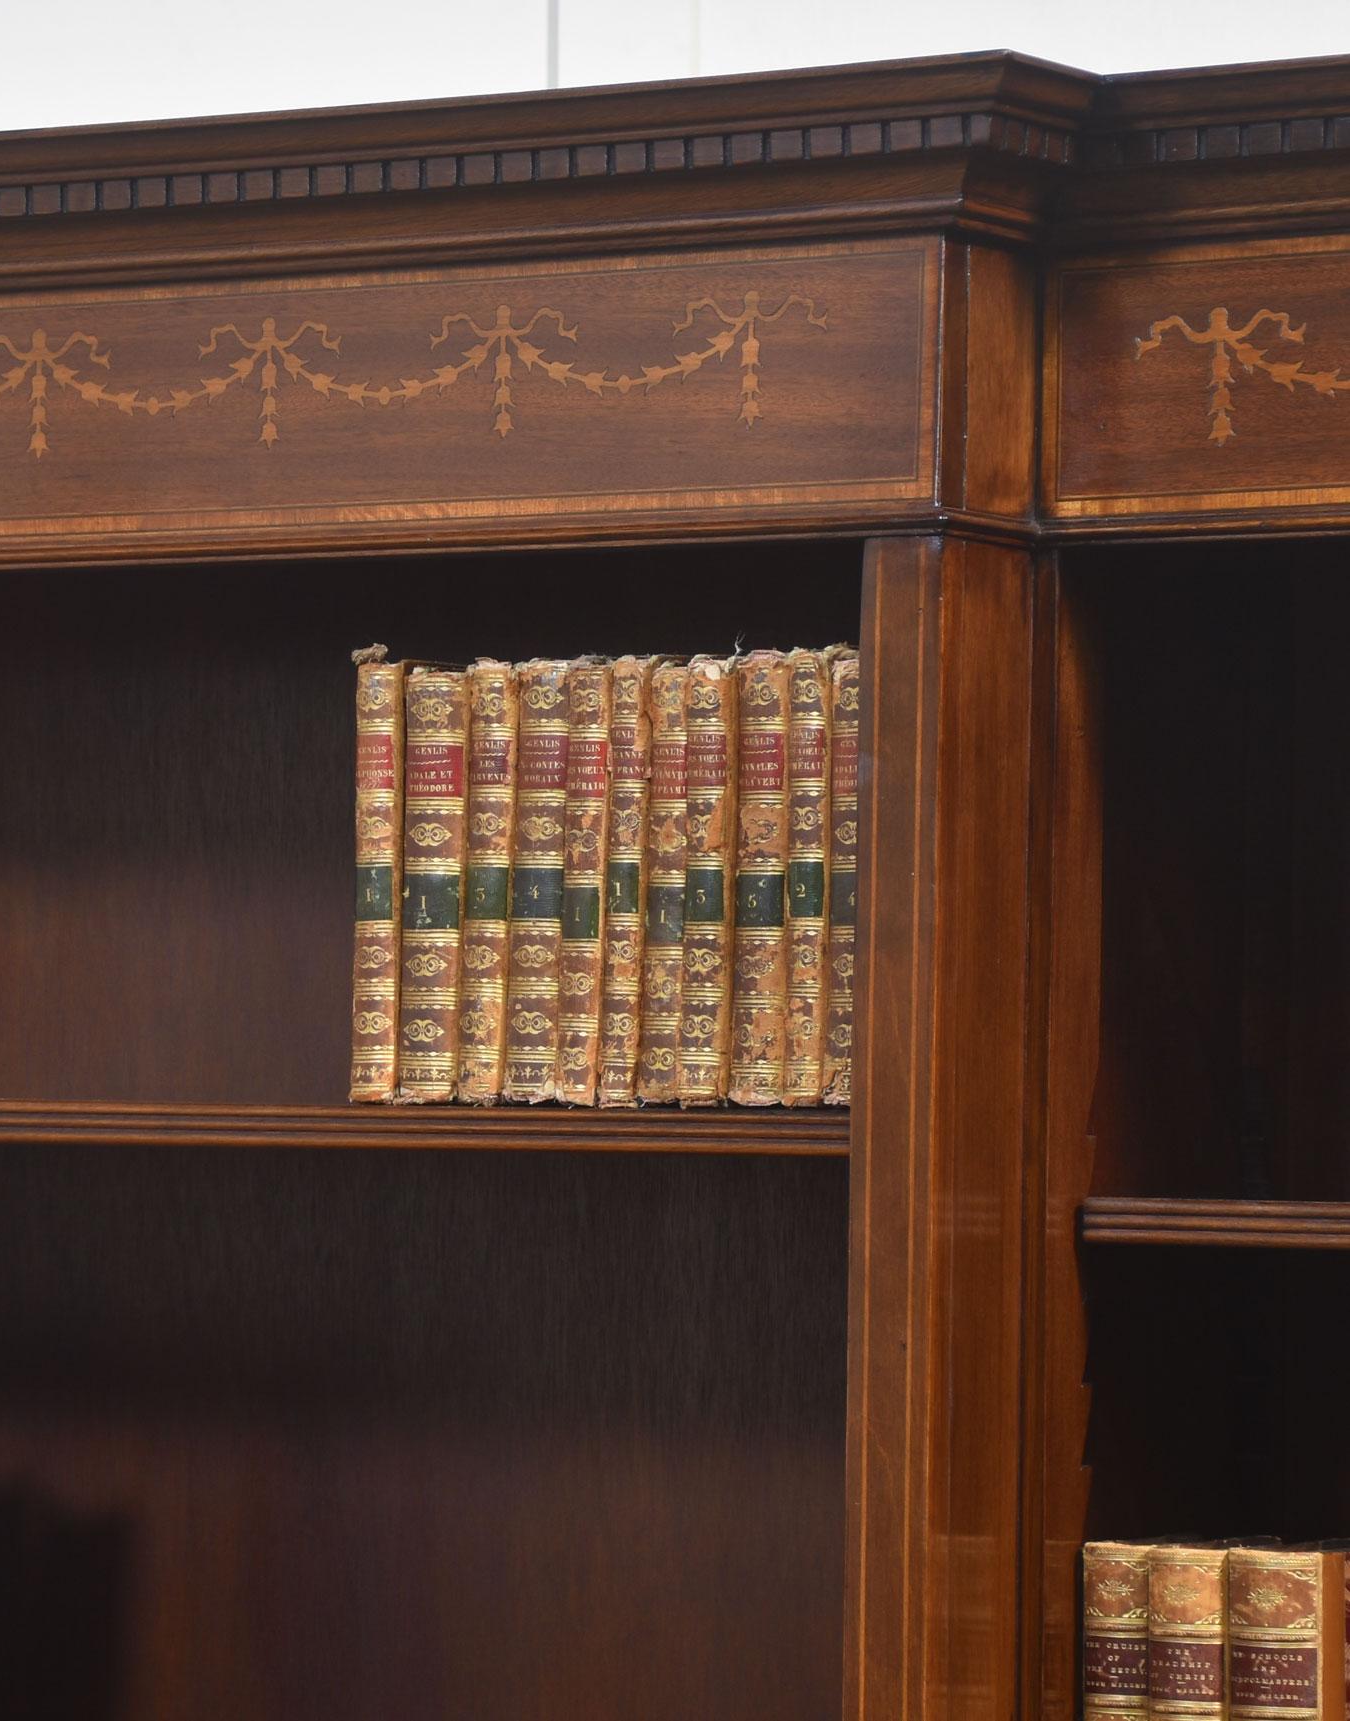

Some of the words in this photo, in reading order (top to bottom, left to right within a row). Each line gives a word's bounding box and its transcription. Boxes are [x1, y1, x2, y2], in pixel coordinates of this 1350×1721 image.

[415, 747, 448, 756] GENLIS
[479, 760, 496, 768] LES
[530, 761, 566, 770] CONTES
[440, 770, 454, 779] ET
[1251, 1652, 1303, 1661] SCHOOLS
